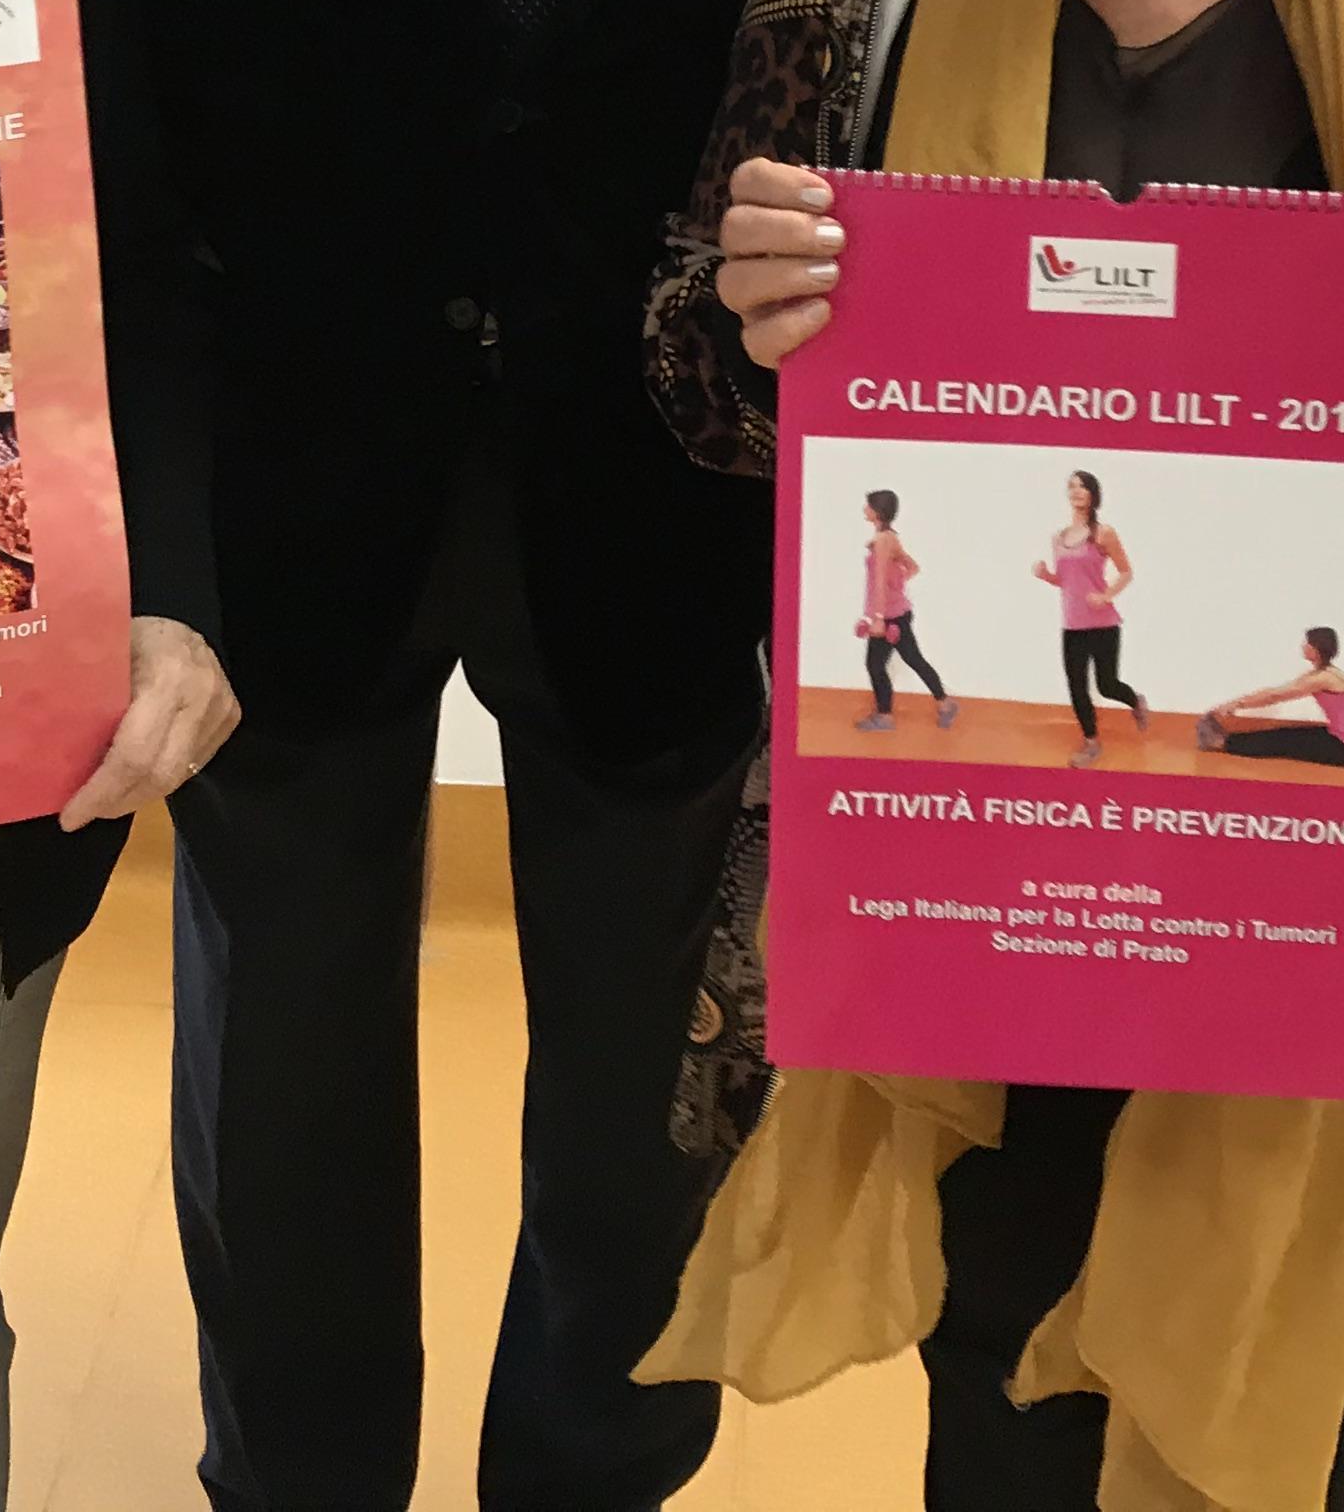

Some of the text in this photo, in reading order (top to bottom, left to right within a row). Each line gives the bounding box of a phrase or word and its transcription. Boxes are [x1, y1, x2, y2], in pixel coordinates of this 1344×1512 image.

[1094, 266, 1156, 288] LILT
[847, 377, 1138, 422] CALENDARIO
[1149, 390, 1242, 427] LILT
[1251, 412, 1269, 421] -
[828, 789, 976, 822] ATTIVITÀ
[984, 798, 1094, 830] FISICA
[1100, 796, 1123, 831] È
[1020, 879, 1163, 905] a cura della
[849, 894, 1338, 945] Lega Italiana per la Lotta contro i Tumori
[990, 929, 1190, 964] Sezione di Prato
